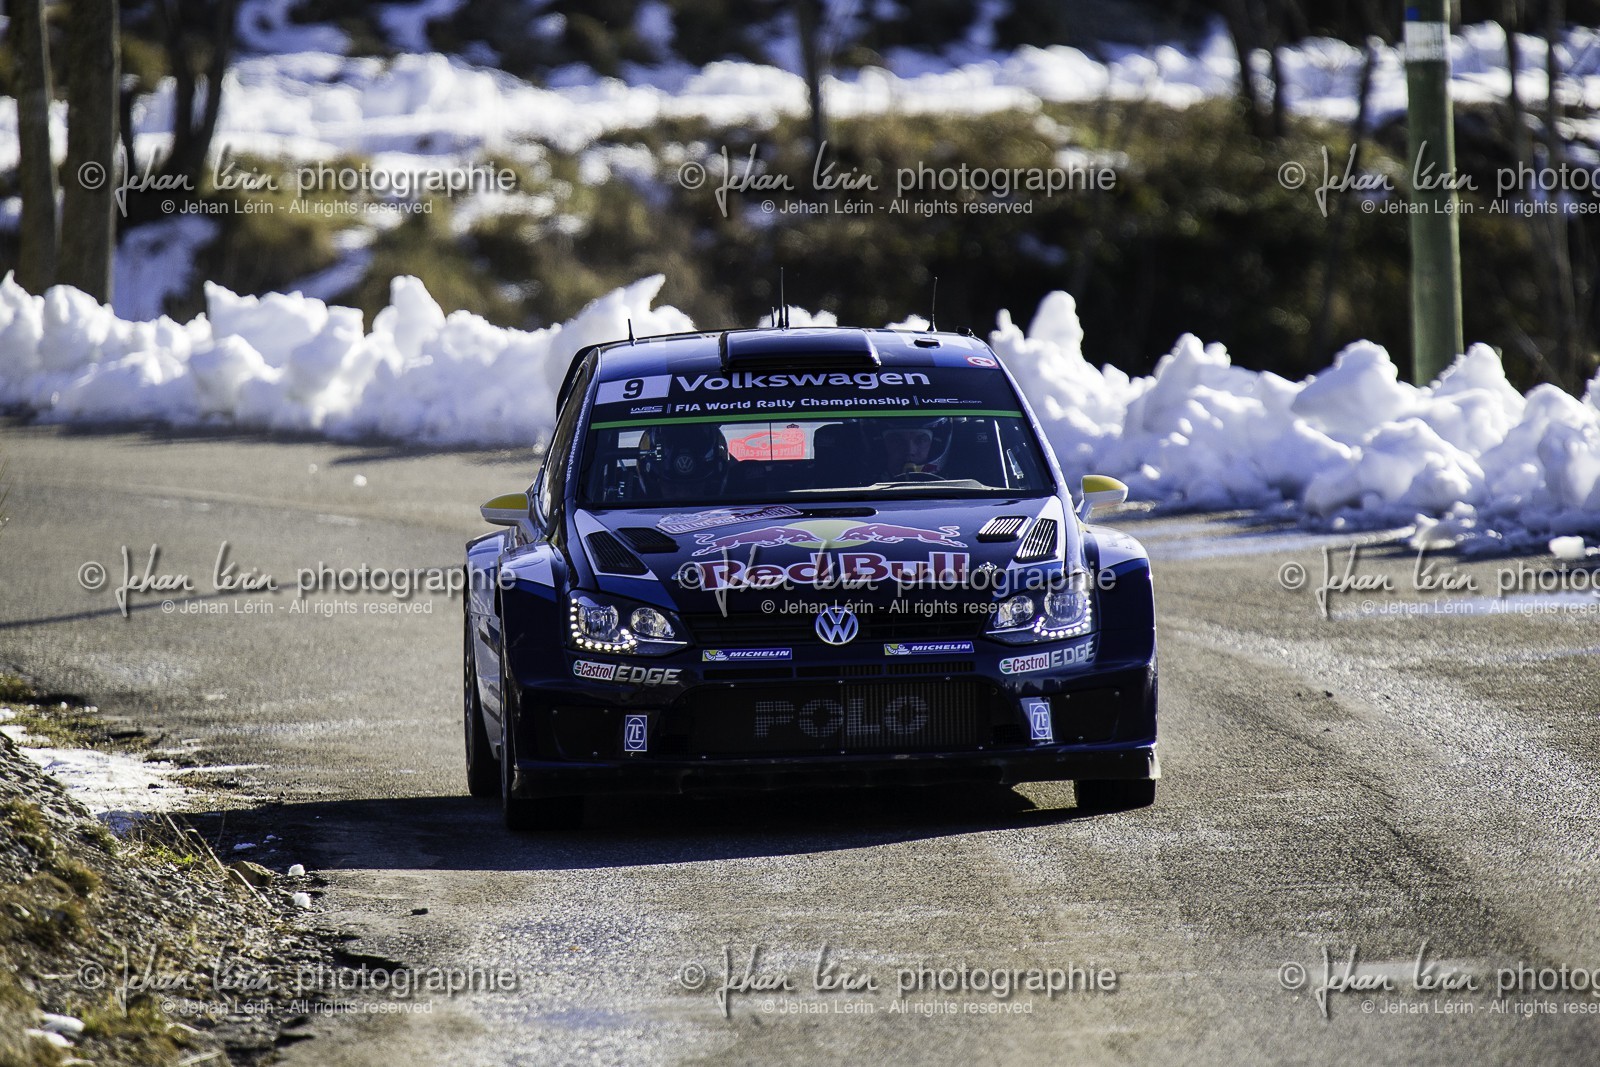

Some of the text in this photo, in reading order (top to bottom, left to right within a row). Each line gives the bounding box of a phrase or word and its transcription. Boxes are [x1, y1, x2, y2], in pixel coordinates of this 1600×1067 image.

[623, 378, 644, 399] 9
[676, 371, 931, 391] Volkswagen
[675, 403, 701, 412] FIA
[706, 400, 751, 411] World
[757, 398, 795, 409] Rally
[801, 396, 910, 408] Championship
[694, 551, 970, 591] Red Bull
[729, 649, 790, 658] MICHELIN
[911, 642, 971, 652] MICHELIN
[1012, 641, 1095, 672] Castrol EDGE
[580, 662, 683, 685] Castrol EDGE
[755, 696, 929, 738] POLO
